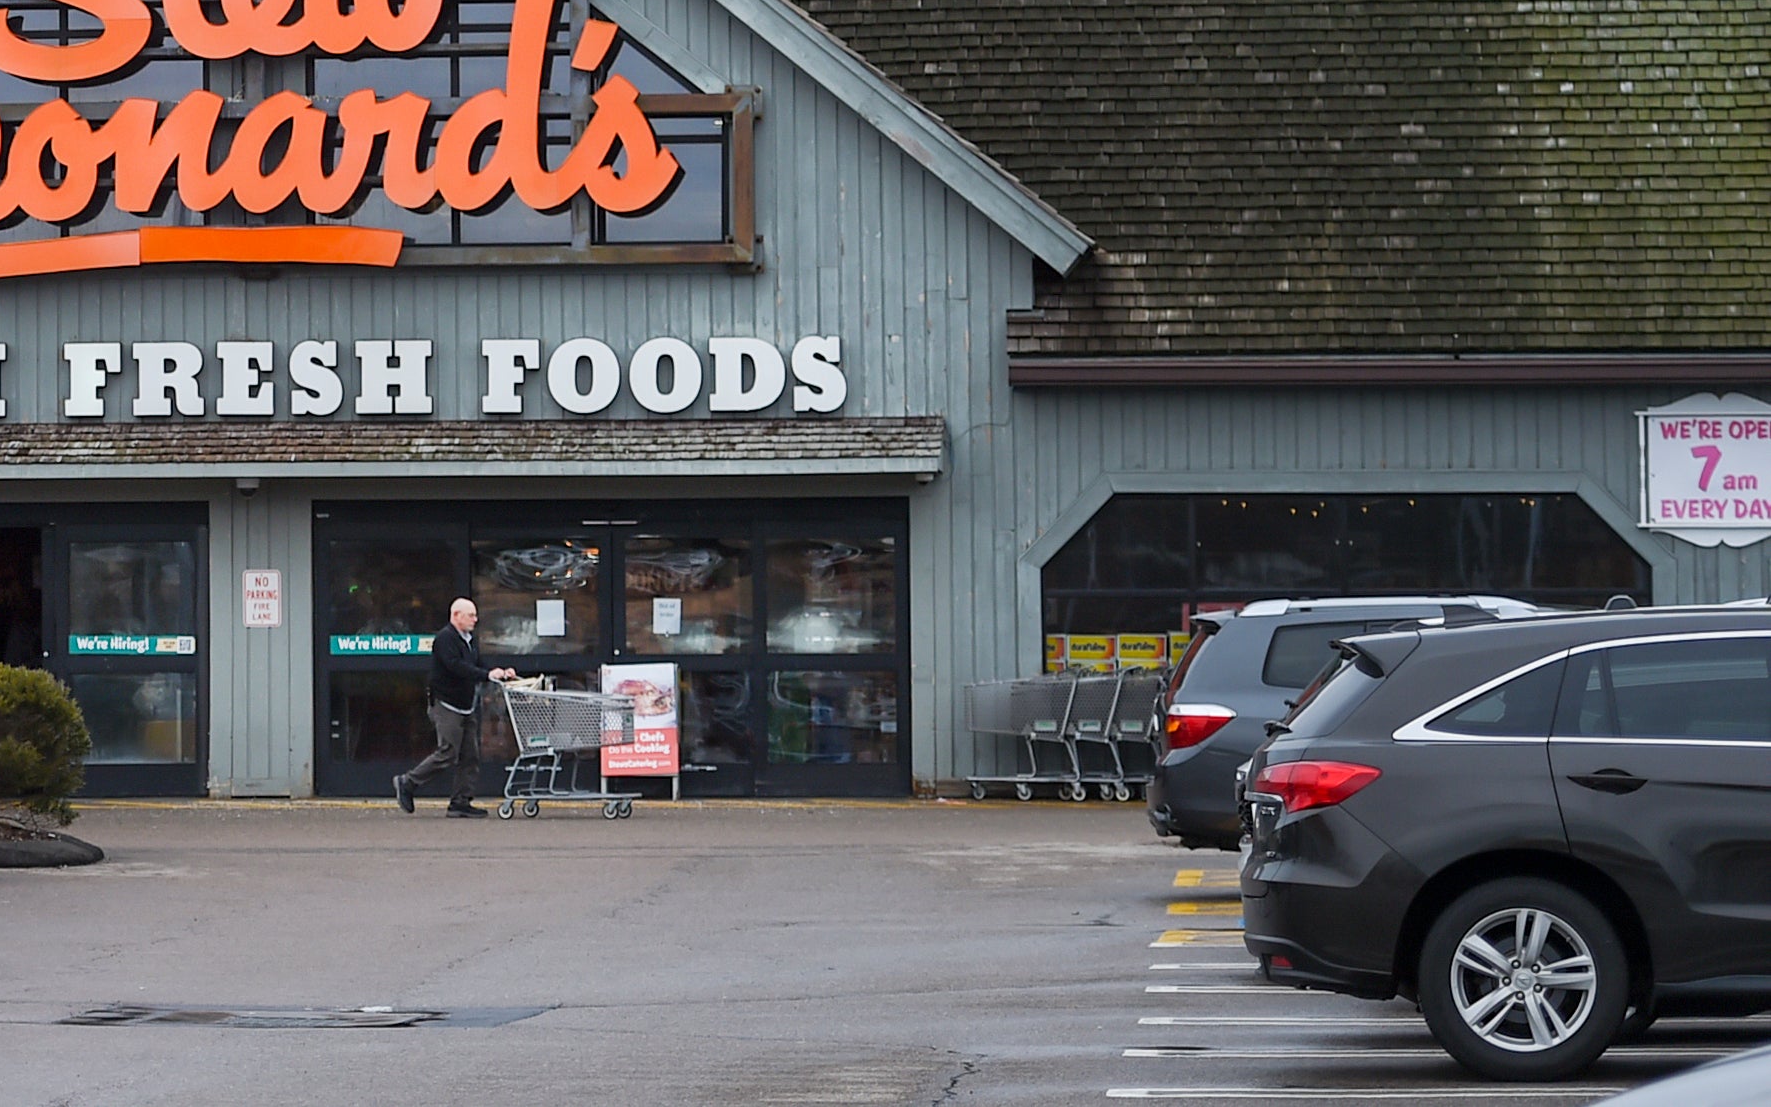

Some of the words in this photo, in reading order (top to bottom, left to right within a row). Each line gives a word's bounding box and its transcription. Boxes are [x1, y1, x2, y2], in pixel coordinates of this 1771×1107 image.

[63, 339, 433, 417] FRESH
[481, 335, 848, 415] FOODS
[1660, 418, 1723, 440] WE'RE
[1728, 419, 1771, 440] OPE
[1691, 445, 1722, 492] 7
[1723, 474, 1758, 490] am
[1661, 498, 1728, 519] EVERY
[255, 576, 269, 587] NO
[246, 590, 278, 600] PARKING
[76, 635, 109, 650] We're
[110, 636, 150, 653] Hiring!
[338, 635, 370, 650] We're
[371, 635, 412, 653] Hiring!
[634, 744, 670, 755] Cooking
